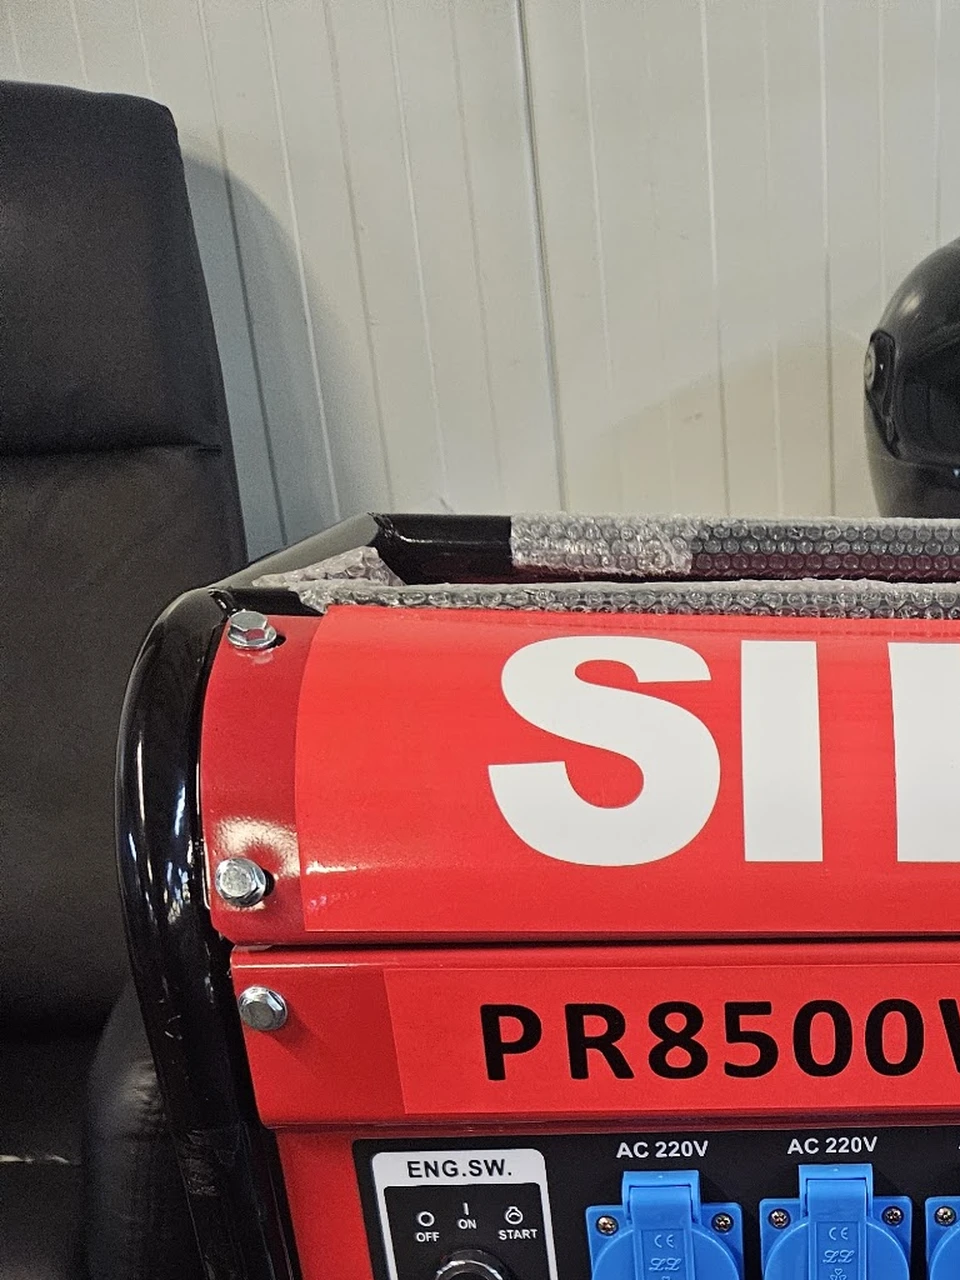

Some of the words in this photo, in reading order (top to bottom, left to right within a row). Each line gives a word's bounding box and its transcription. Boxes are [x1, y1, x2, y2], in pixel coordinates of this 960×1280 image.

[616, 1141, 651, 1159] AC
[655, 1140, 709, 1158] 220V
[787, 1138, 822, 1155] AC
[826, 1136, 878, 1154] 220V
[407, 1159, 512, 1178] ENG.SW.
[457, 1218, 477, 1230] ON
[416, 1231, 440, 1242] OFF
[498, 1229, 538, 1241] START
